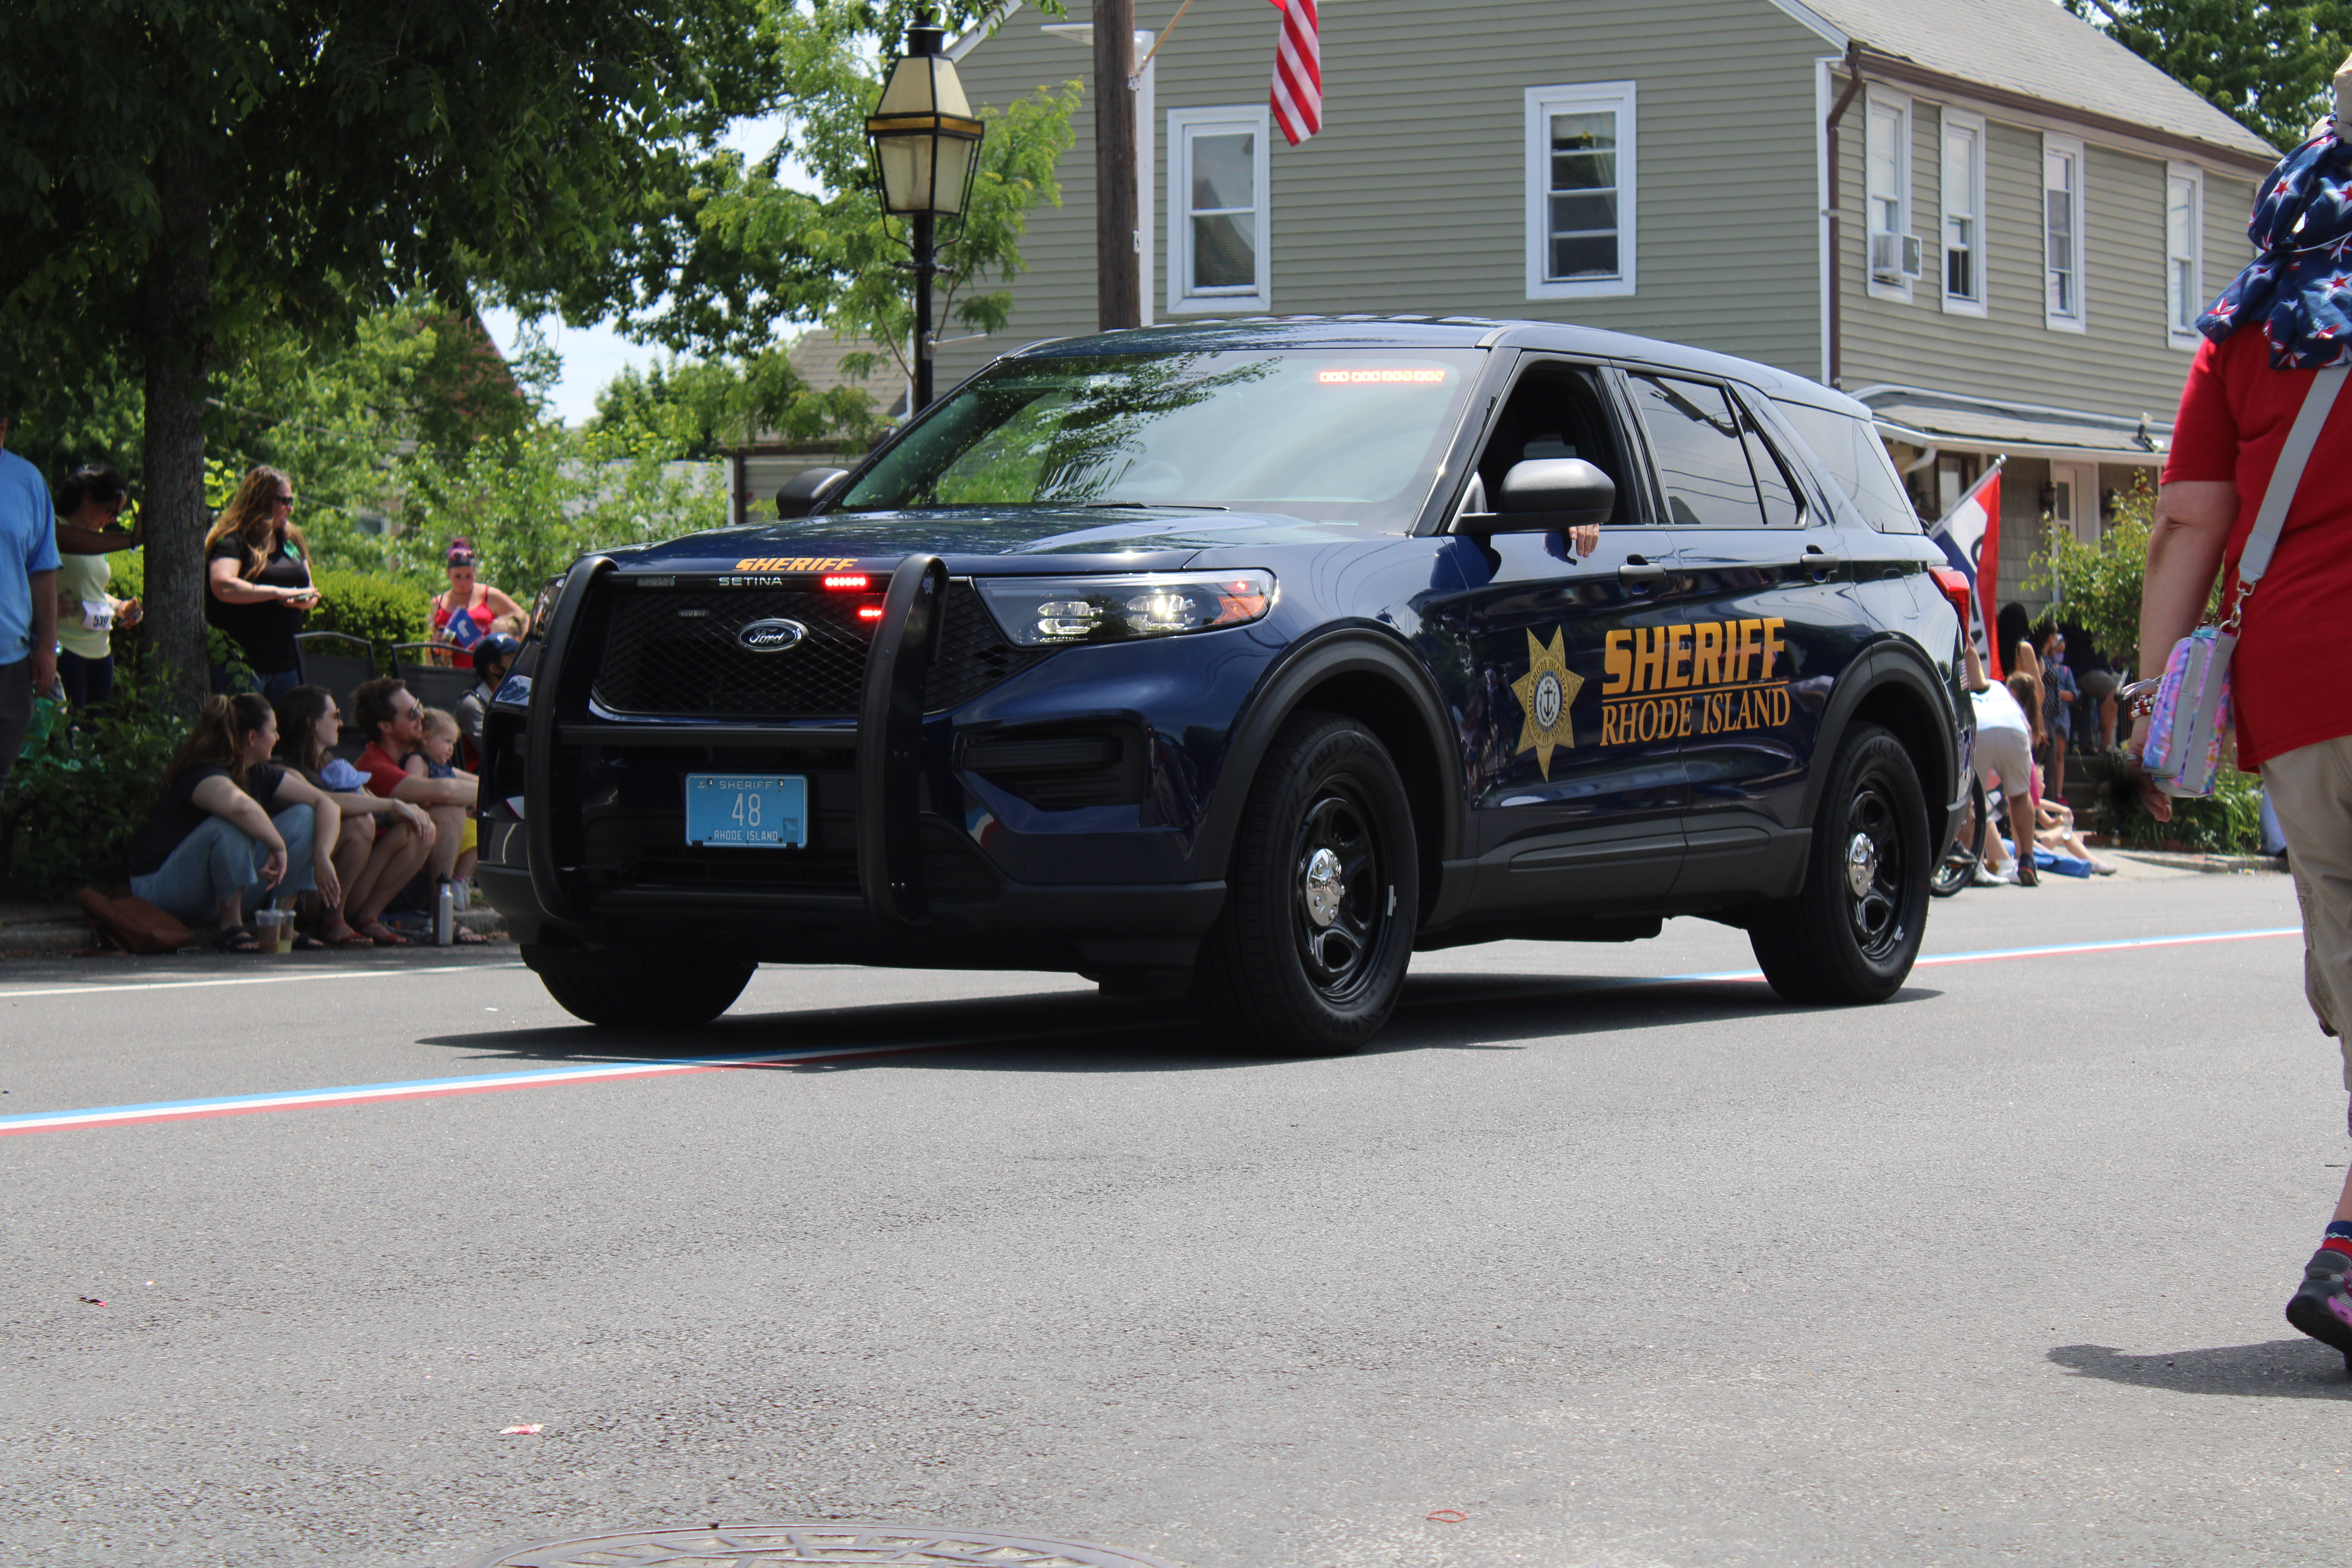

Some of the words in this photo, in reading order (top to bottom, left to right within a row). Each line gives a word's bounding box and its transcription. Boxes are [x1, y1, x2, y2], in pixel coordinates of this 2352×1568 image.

[733, 557, 859, 571] SHERIFF
[719, 577, 783, 586] SETINA
[749, 628, 786, 644] Ford
[1602, 617, 1785, 695] SHERIFF
[1530, 659, 1547, 687] RHODE
[1549, 659, 1566, 686] ISLAND
[1528, 695, 1541, 741] DIVISION
[1542, 735, 1549, 743] OF
[1552, 695, 1568, 740] SHERIFFS
[1600, 696, 1693, 746] RHODE
[1700, 688, 1790, 735] ISLAND
[719, 780, 773, 789] SHERIFF
[731, 793, 761, 827] 48
[714, 830, 742, 840] RHODE
[747, 830, 779, 841] ISLAND
